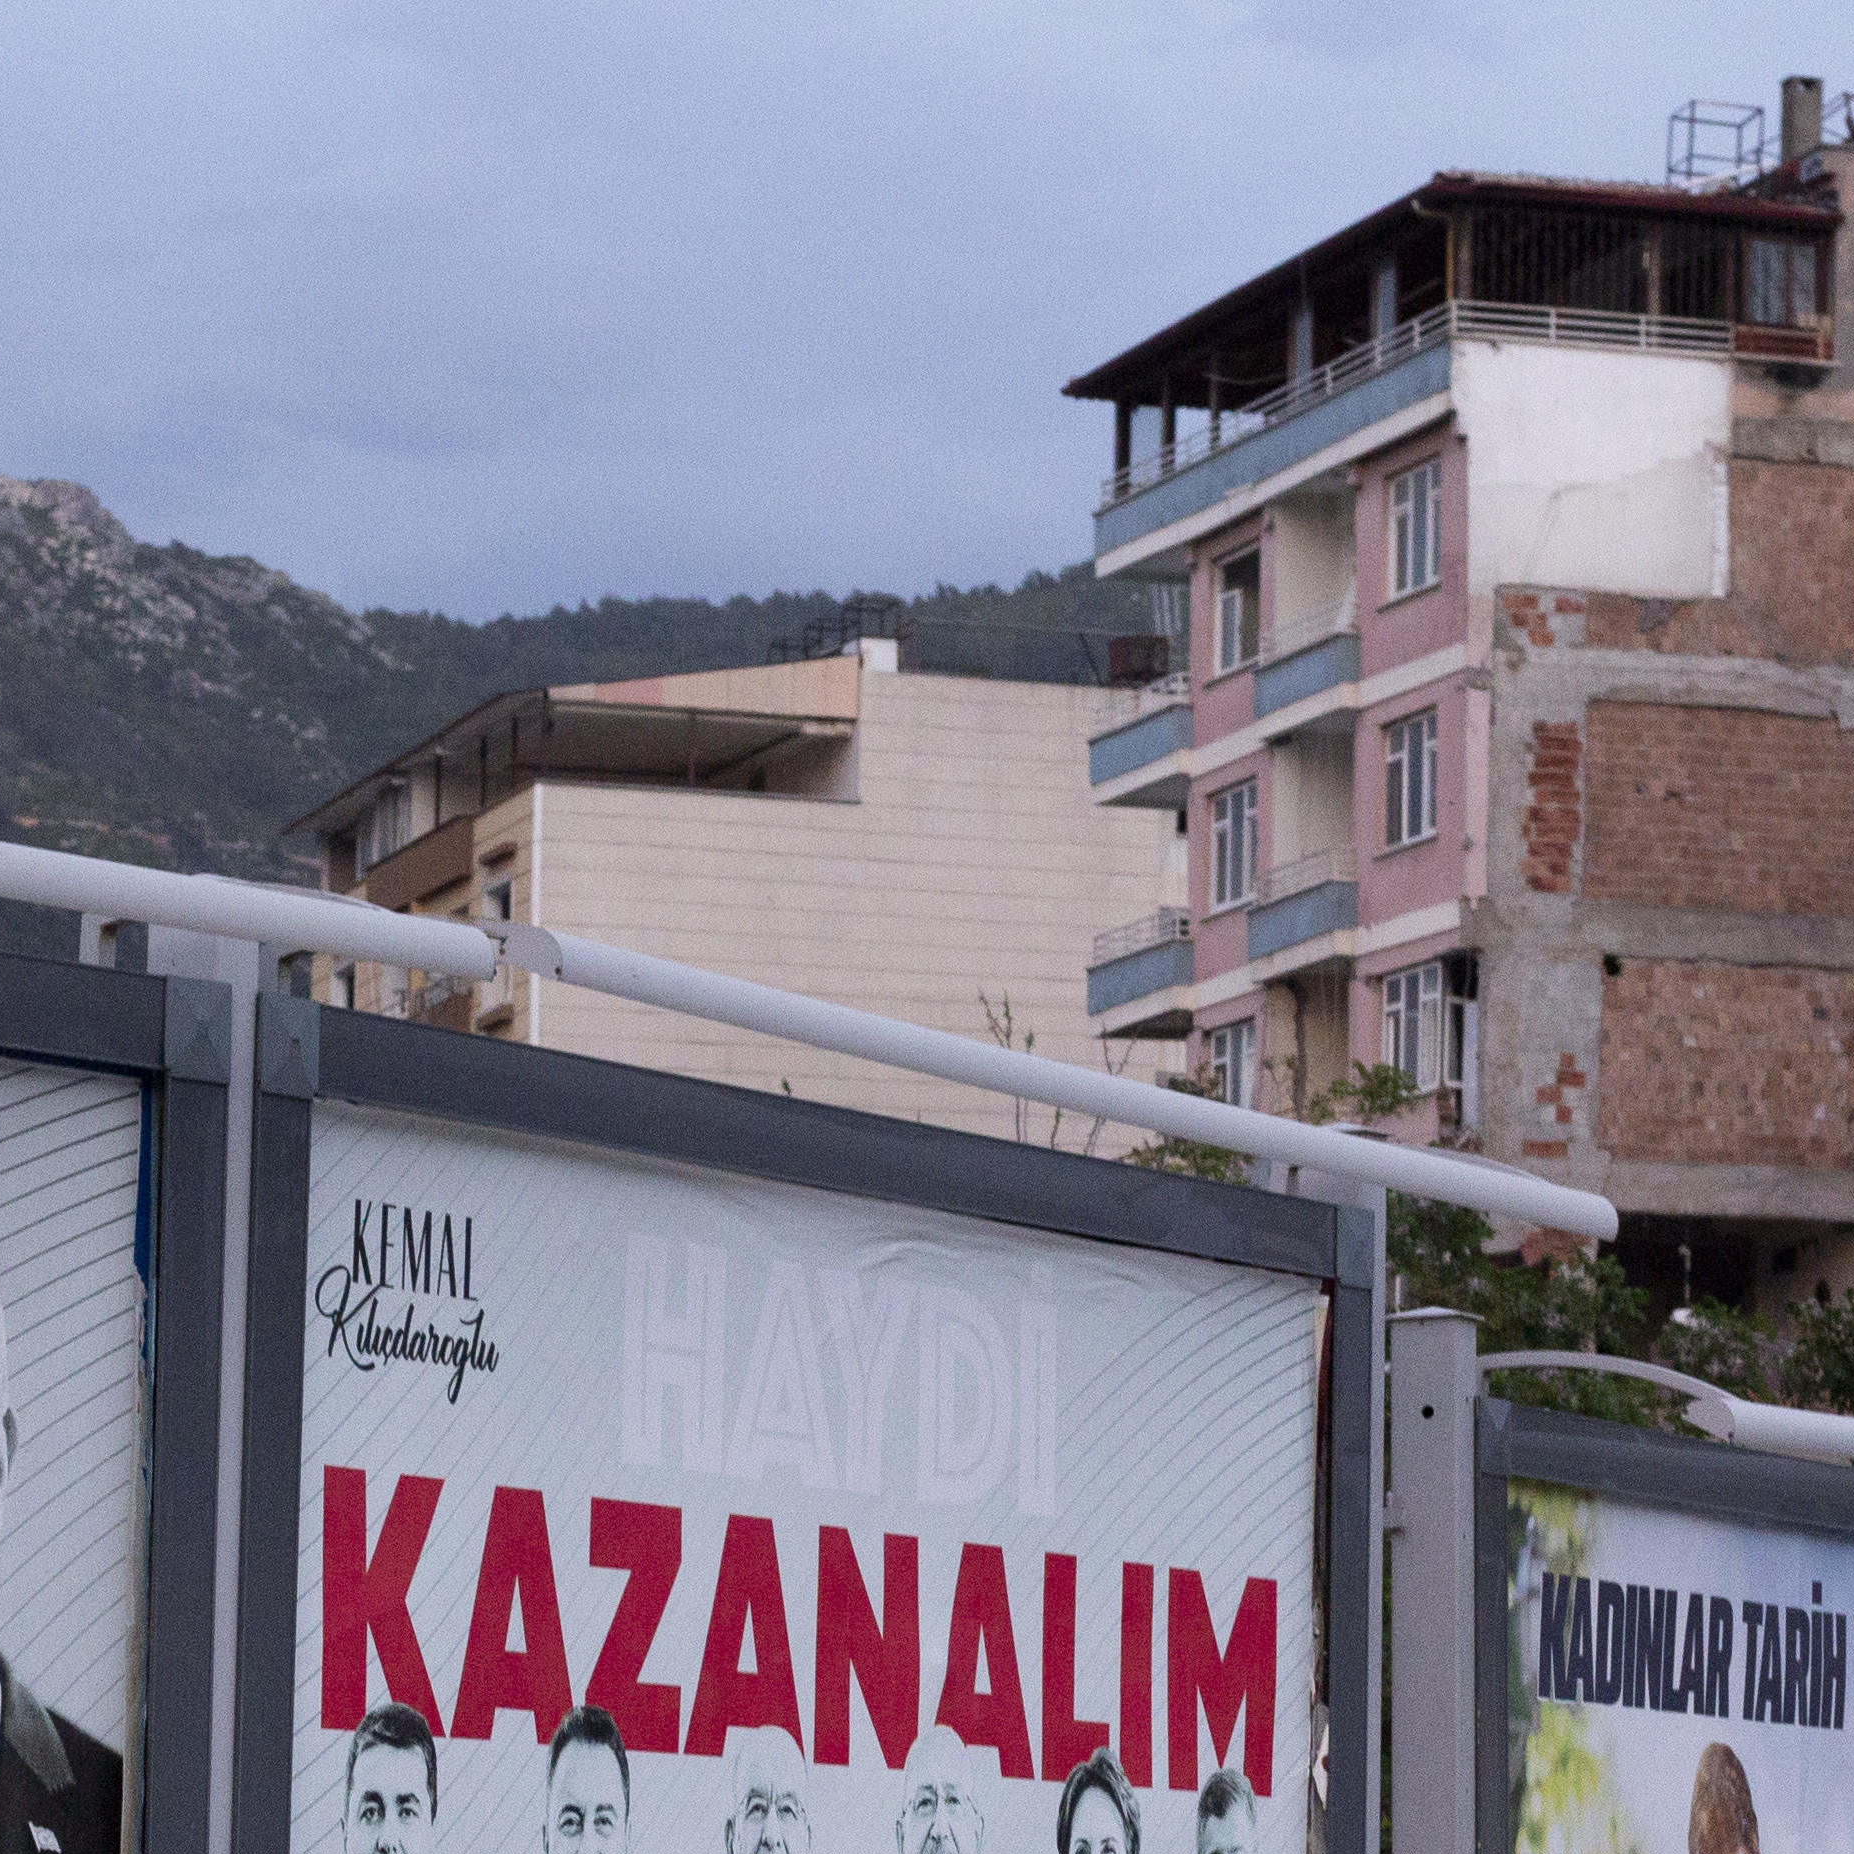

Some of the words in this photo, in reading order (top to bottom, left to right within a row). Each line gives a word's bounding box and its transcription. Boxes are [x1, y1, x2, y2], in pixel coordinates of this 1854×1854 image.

[352, 1199, 478, 1301] KEMAL
[319, 1464, 1277, 1797] KAZANALIM
[1538, 1571, 1733, 1718] KADINLAR
[1741, 1581, 1846, 1730] TARİH
